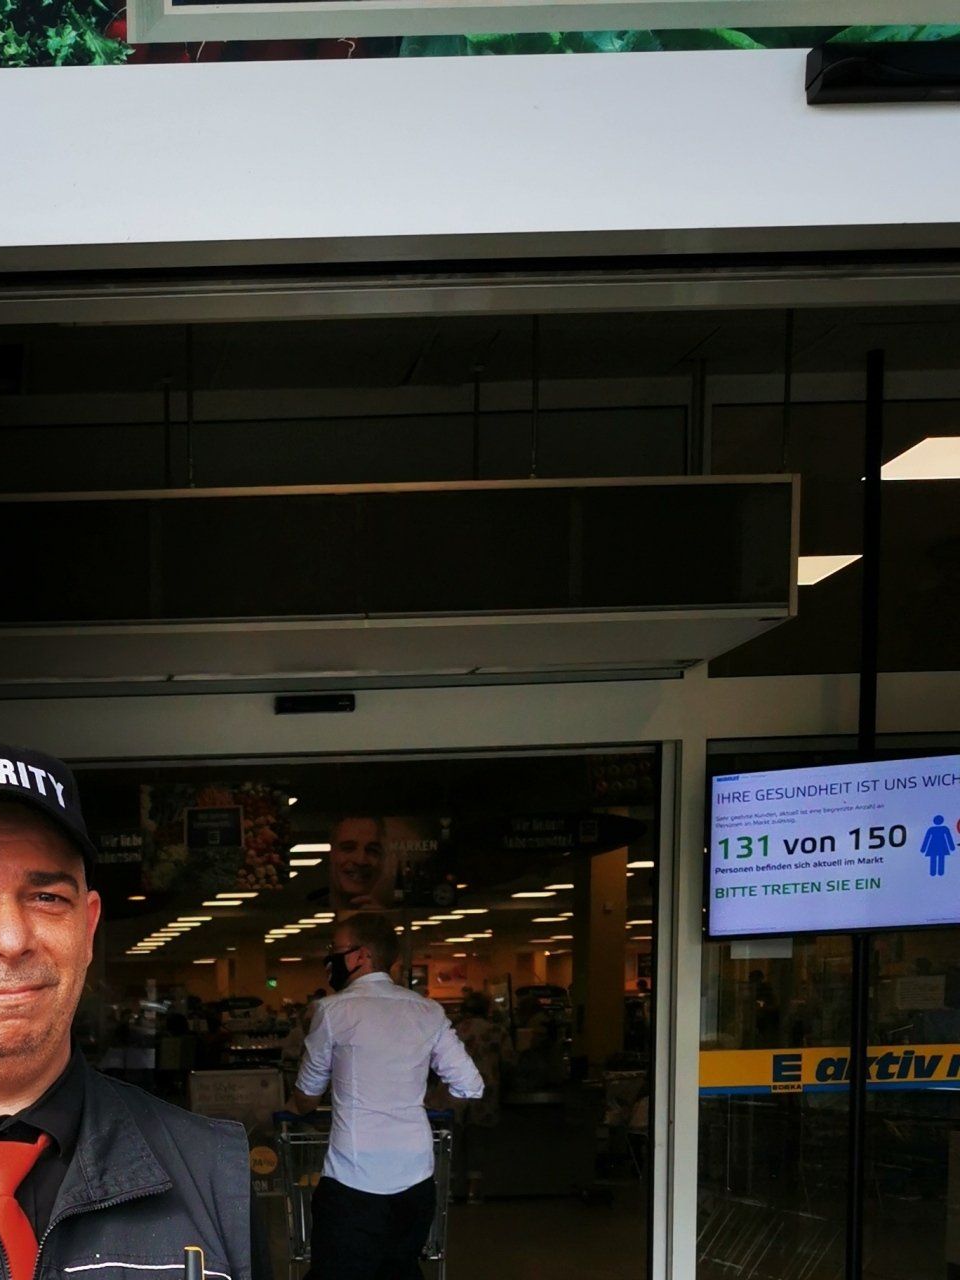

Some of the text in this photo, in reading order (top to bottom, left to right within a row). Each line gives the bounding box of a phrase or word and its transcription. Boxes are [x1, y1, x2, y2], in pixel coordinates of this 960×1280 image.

[717, 790, 751, 805] IHRE
[755, 782, 853, 802] GESUNDHEIT
[857, 780, 880, 793] IST
[884, 777, 918, 791] UNS
[718, 825, 907, 860] 131 von 150
[715, 856, 884, 875] Personen befinden sich aktuell im Markt
[715, 878, 882, 899] BITTE TRETEN SIE EIN
